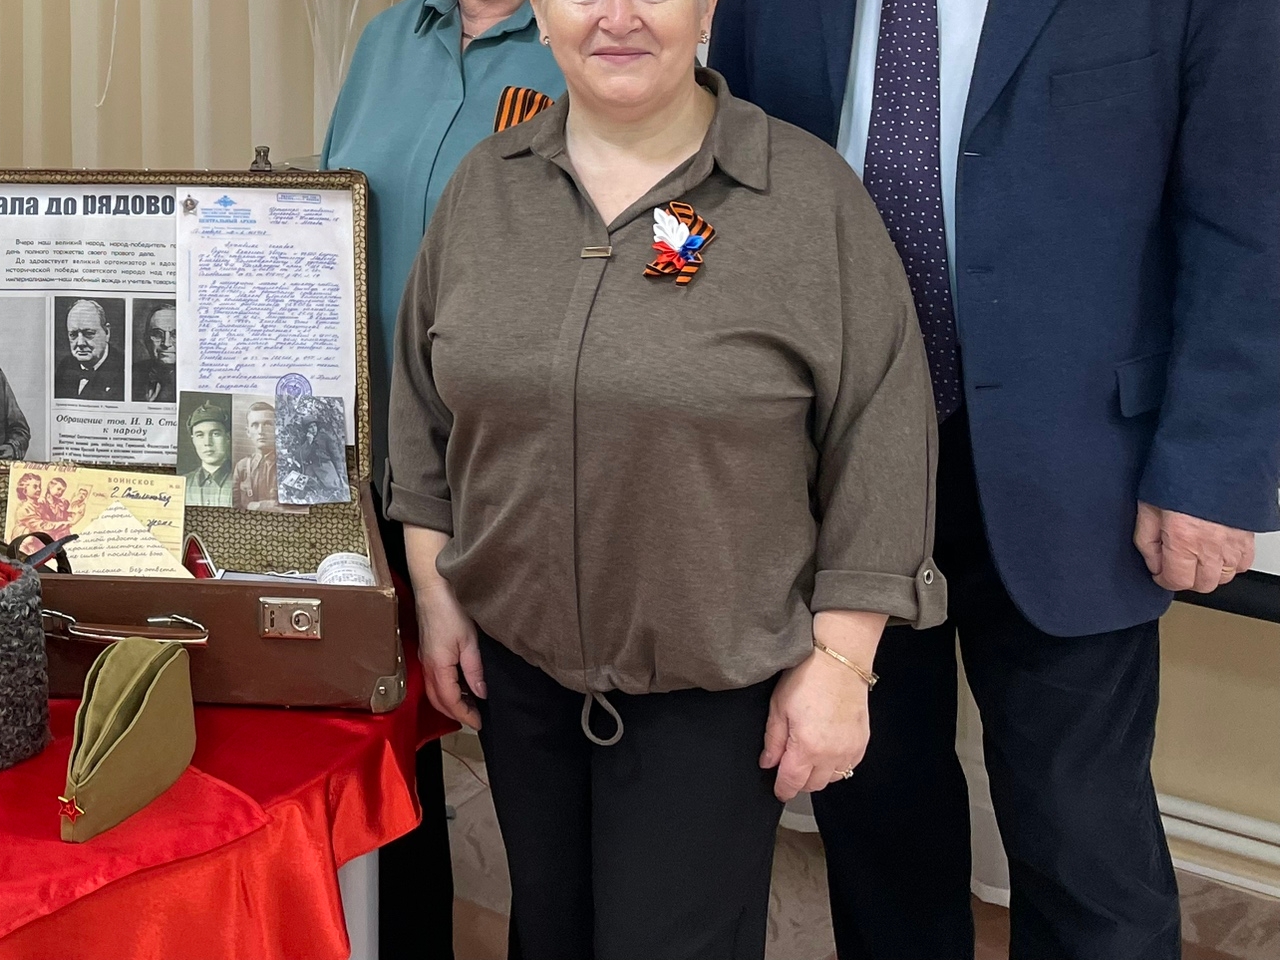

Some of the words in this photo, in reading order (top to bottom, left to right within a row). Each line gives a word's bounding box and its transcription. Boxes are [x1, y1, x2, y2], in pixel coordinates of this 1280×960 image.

[44, 197, 77, 216] до
[56, 414, 104, 425] Обращение
[106, 418, 128, 426] тов.
[130, 416, 141, 426] И.
[145, 417, 155, 426] В.
[113, 427, 148, 436] народу
[107, 476, 155, 487] ВОИНСКОЕ
